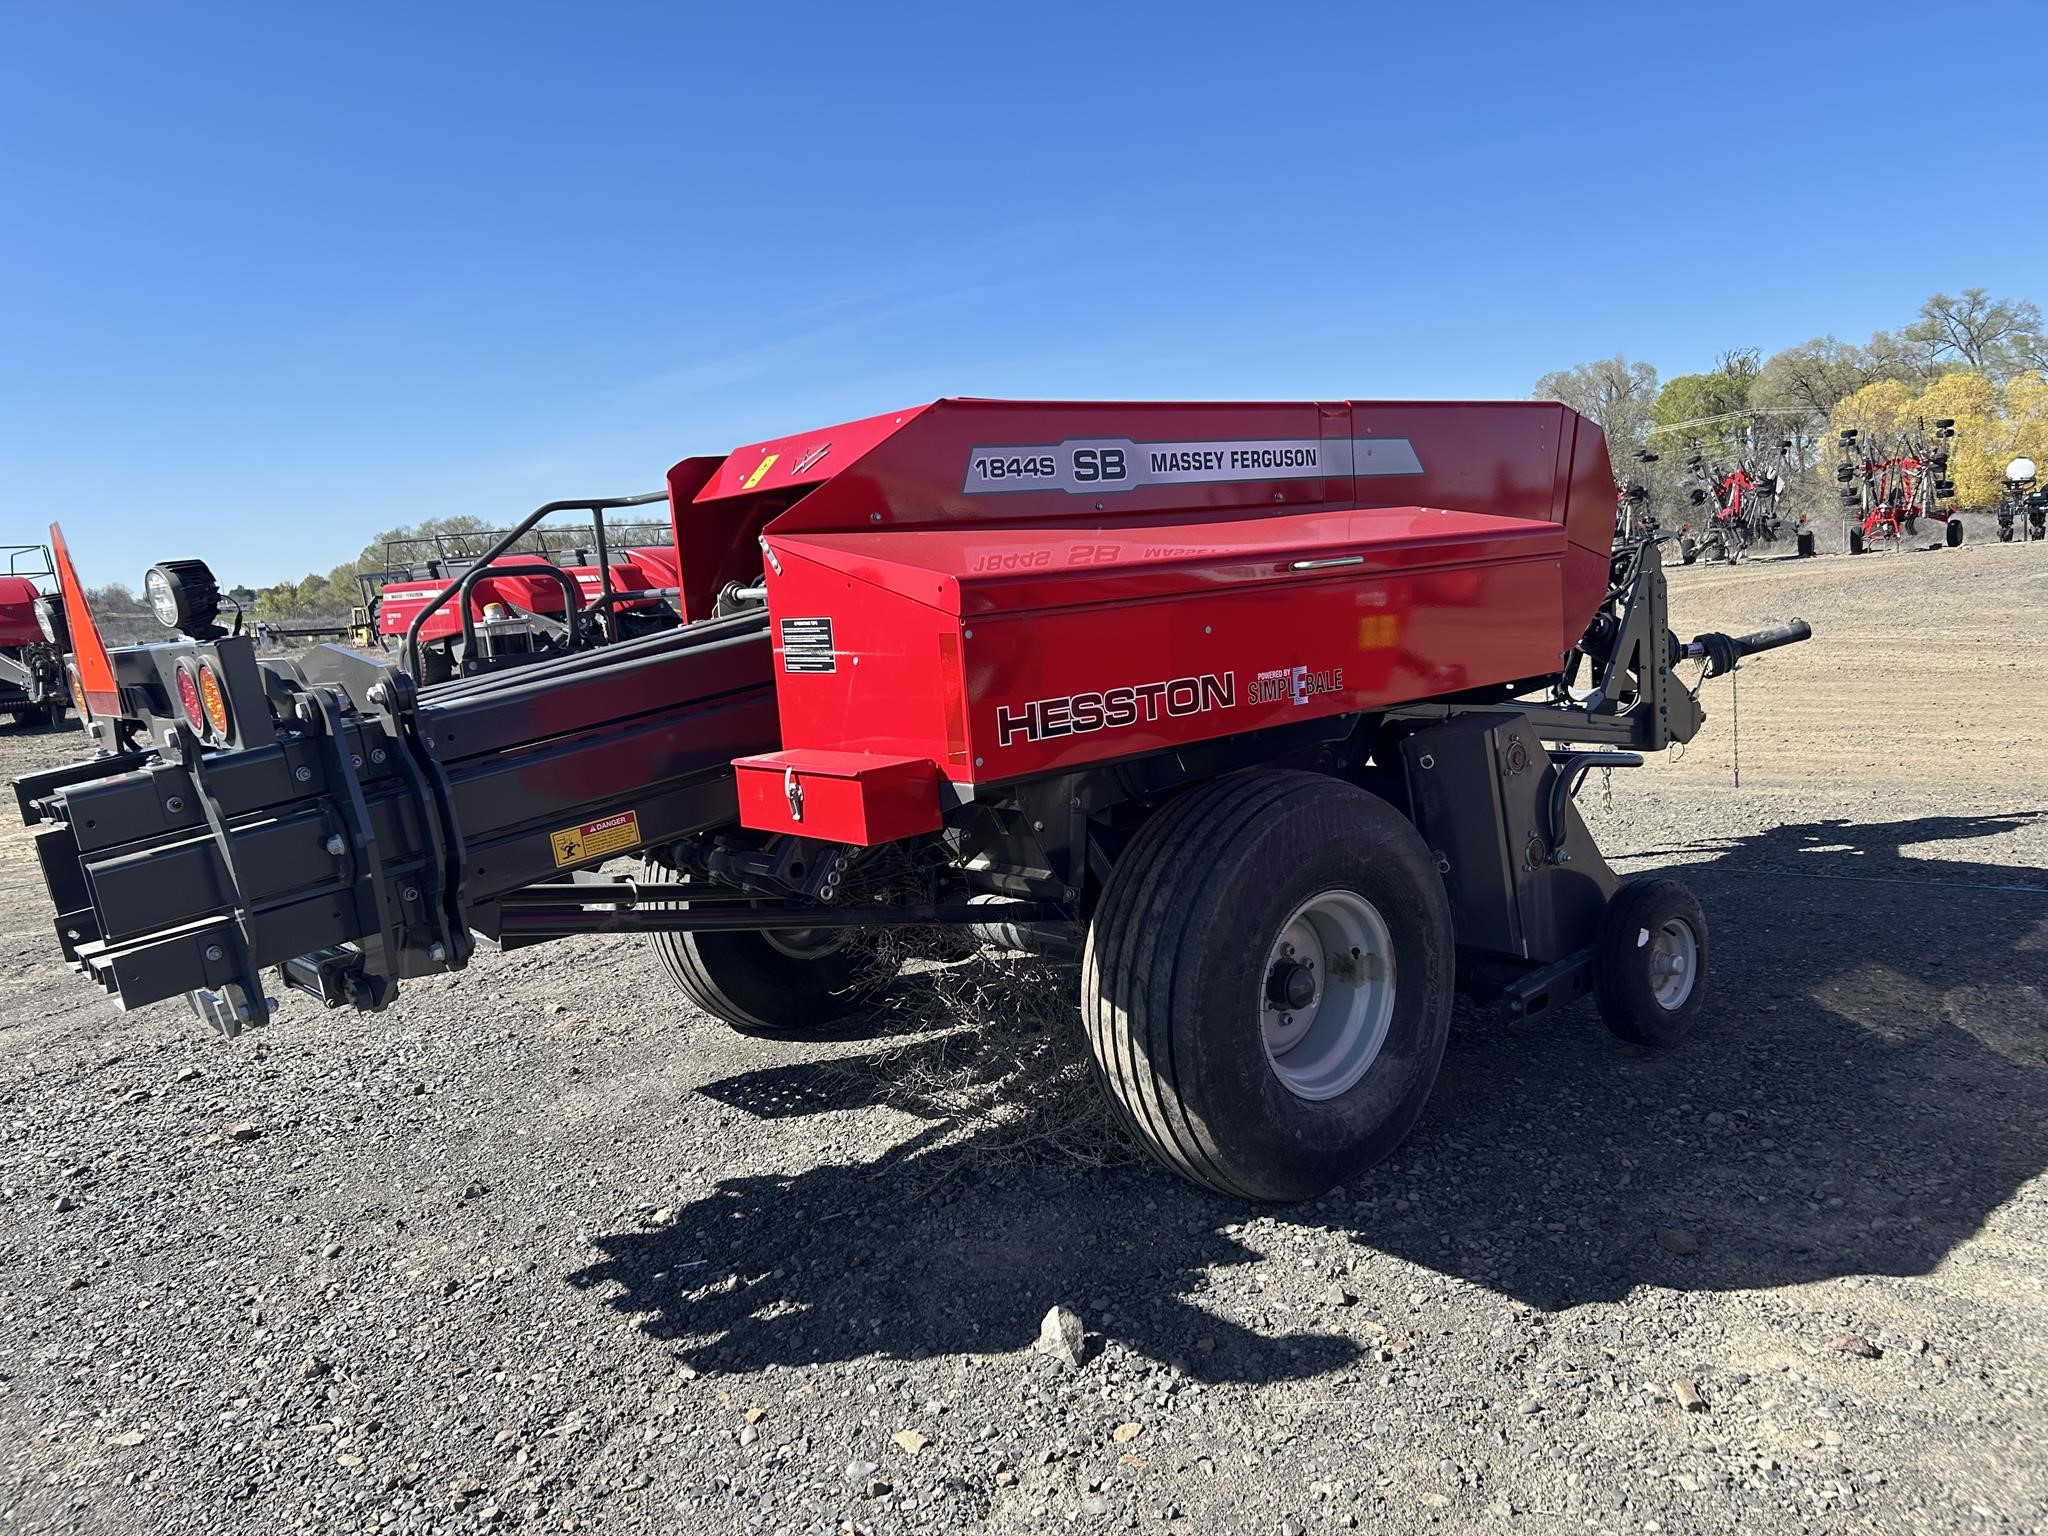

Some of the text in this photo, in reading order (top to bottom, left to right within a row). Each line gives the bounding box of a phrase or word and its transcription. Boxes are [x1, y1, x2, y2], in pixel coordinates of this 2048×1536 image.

[975, 448, 1317, 482] 1844S SB MASSEY FERGUSON
[1257, 668, 1291, 680] POWERED BY
[997, 671, 1236, 747] HESSTON
[596, 816, 627, 831] DANGER
